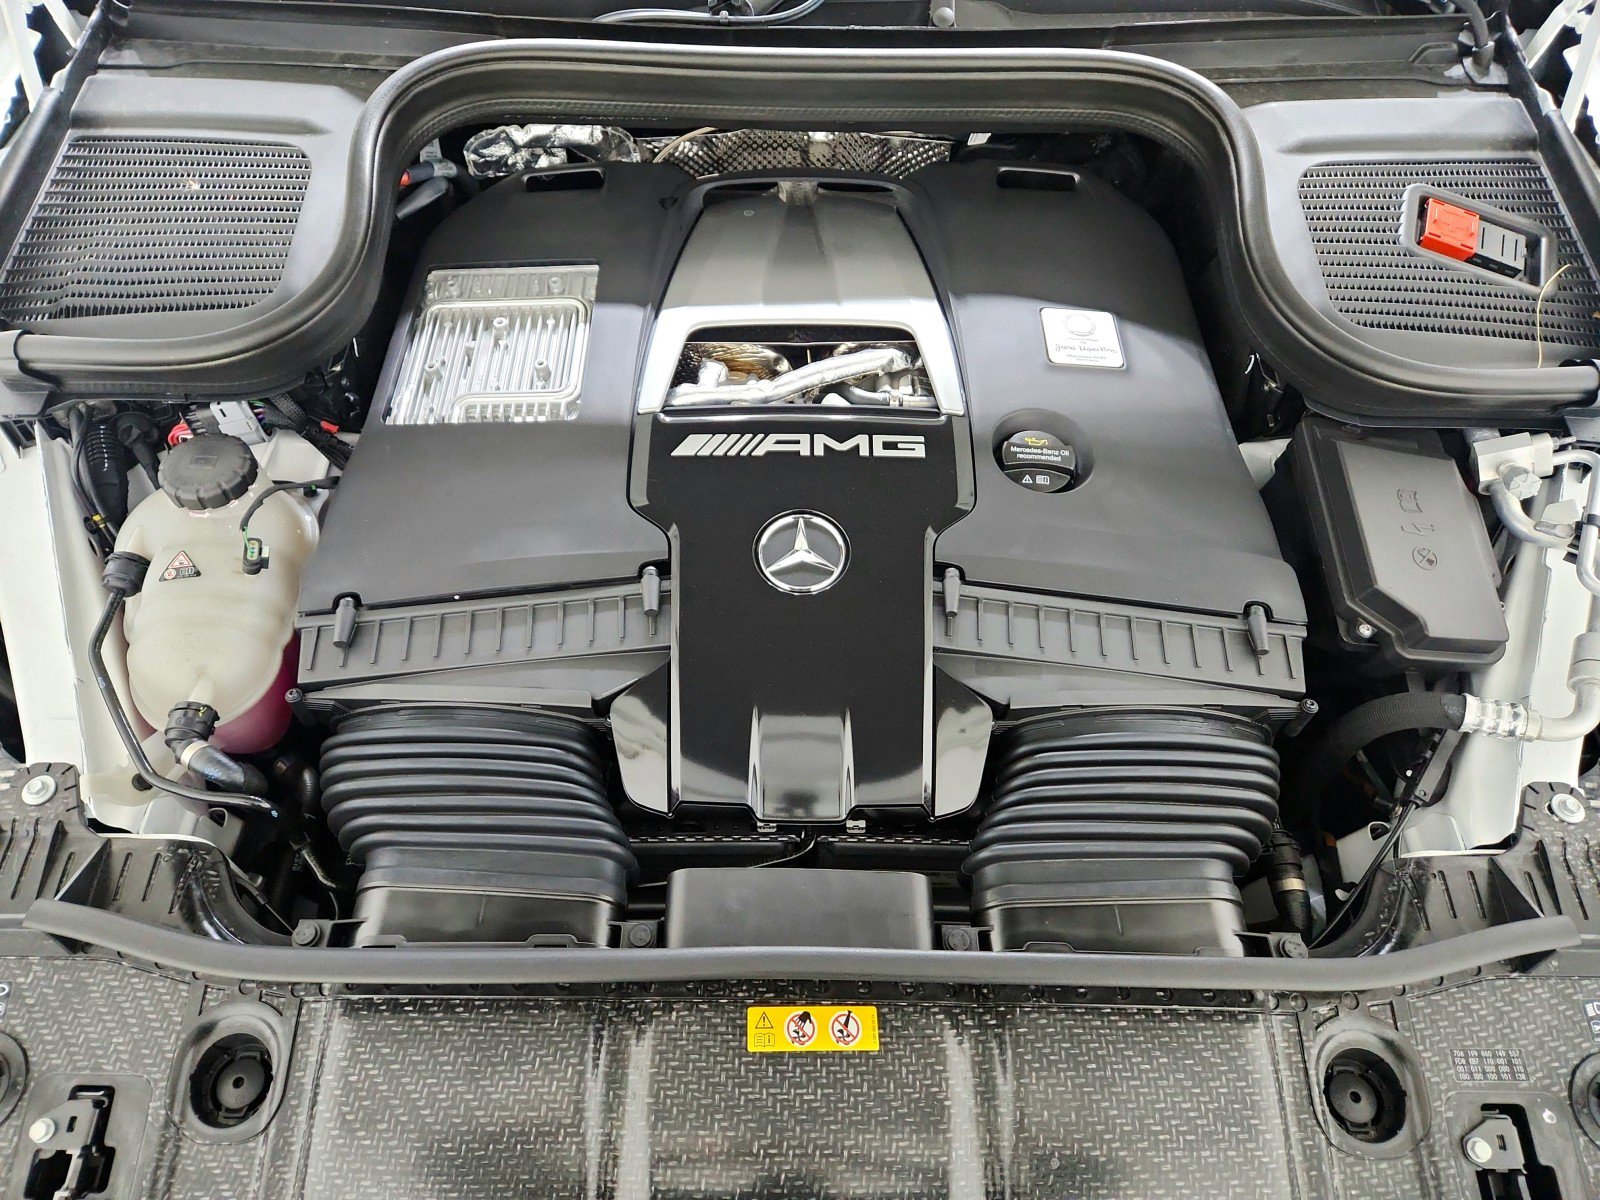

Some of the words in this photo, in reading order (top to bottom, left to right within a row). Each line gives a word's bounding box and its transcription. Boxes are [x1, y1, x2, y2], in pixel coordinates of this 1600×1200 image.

[751, 433, 926, 458] AMG
[1010, 446, 1059, 455] Mercedes-Benz
[1017, 453, 1062, 461] recommended
